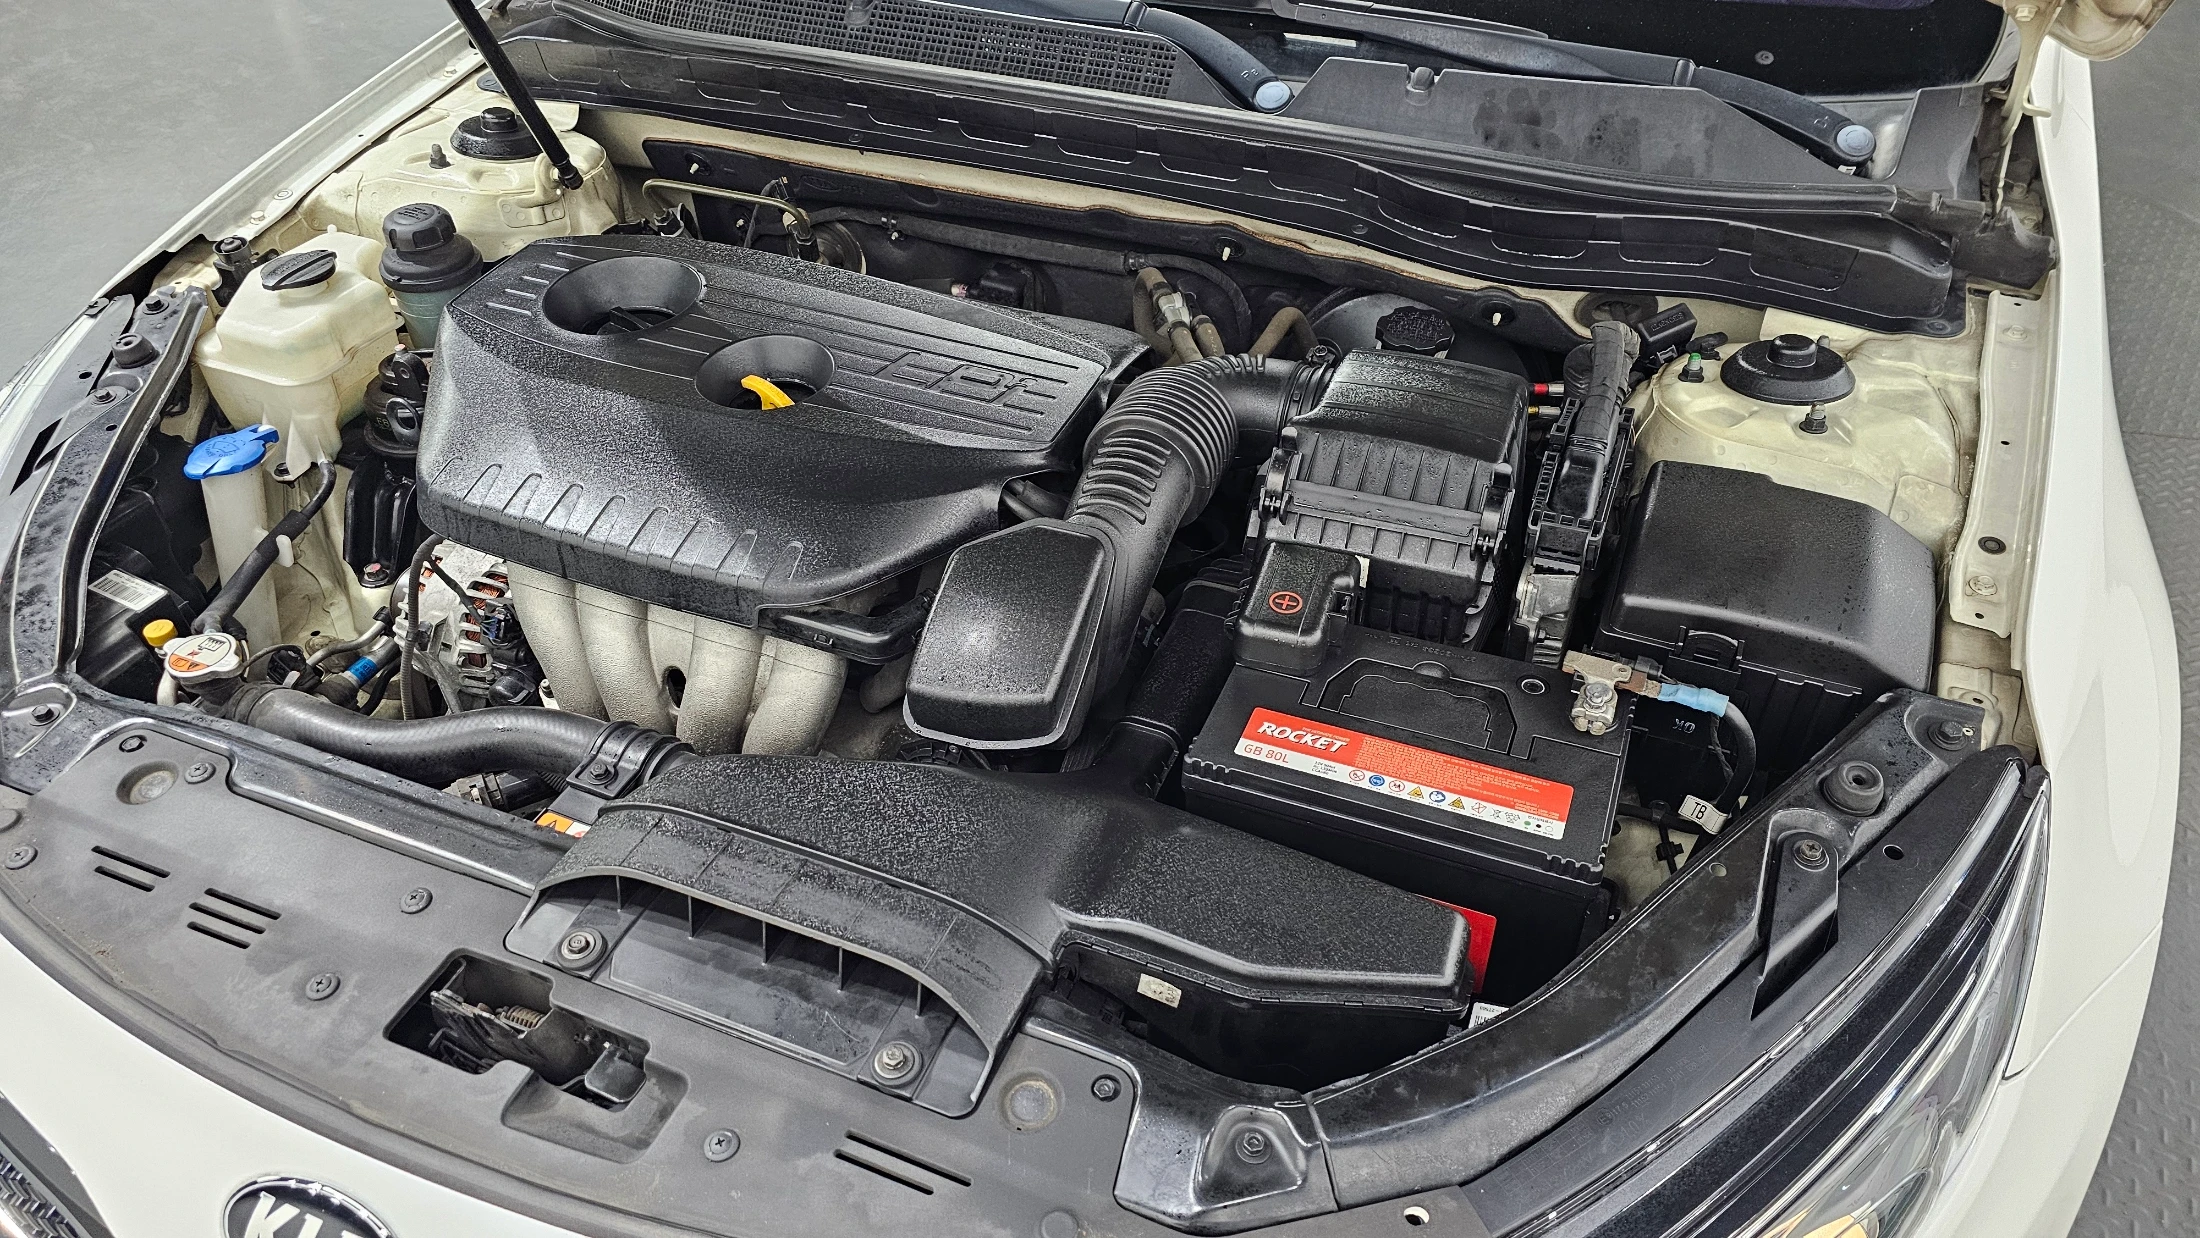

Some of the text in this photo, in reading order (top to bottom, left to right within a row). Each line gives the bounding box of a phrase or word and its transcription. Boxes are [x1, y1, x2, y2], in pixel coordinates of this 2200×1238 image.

[1257, 722, 1348, 753] ROCKET
[1244, 744, 1289, 763] GB 80L
[1690, 801, 1707, 820] TB
